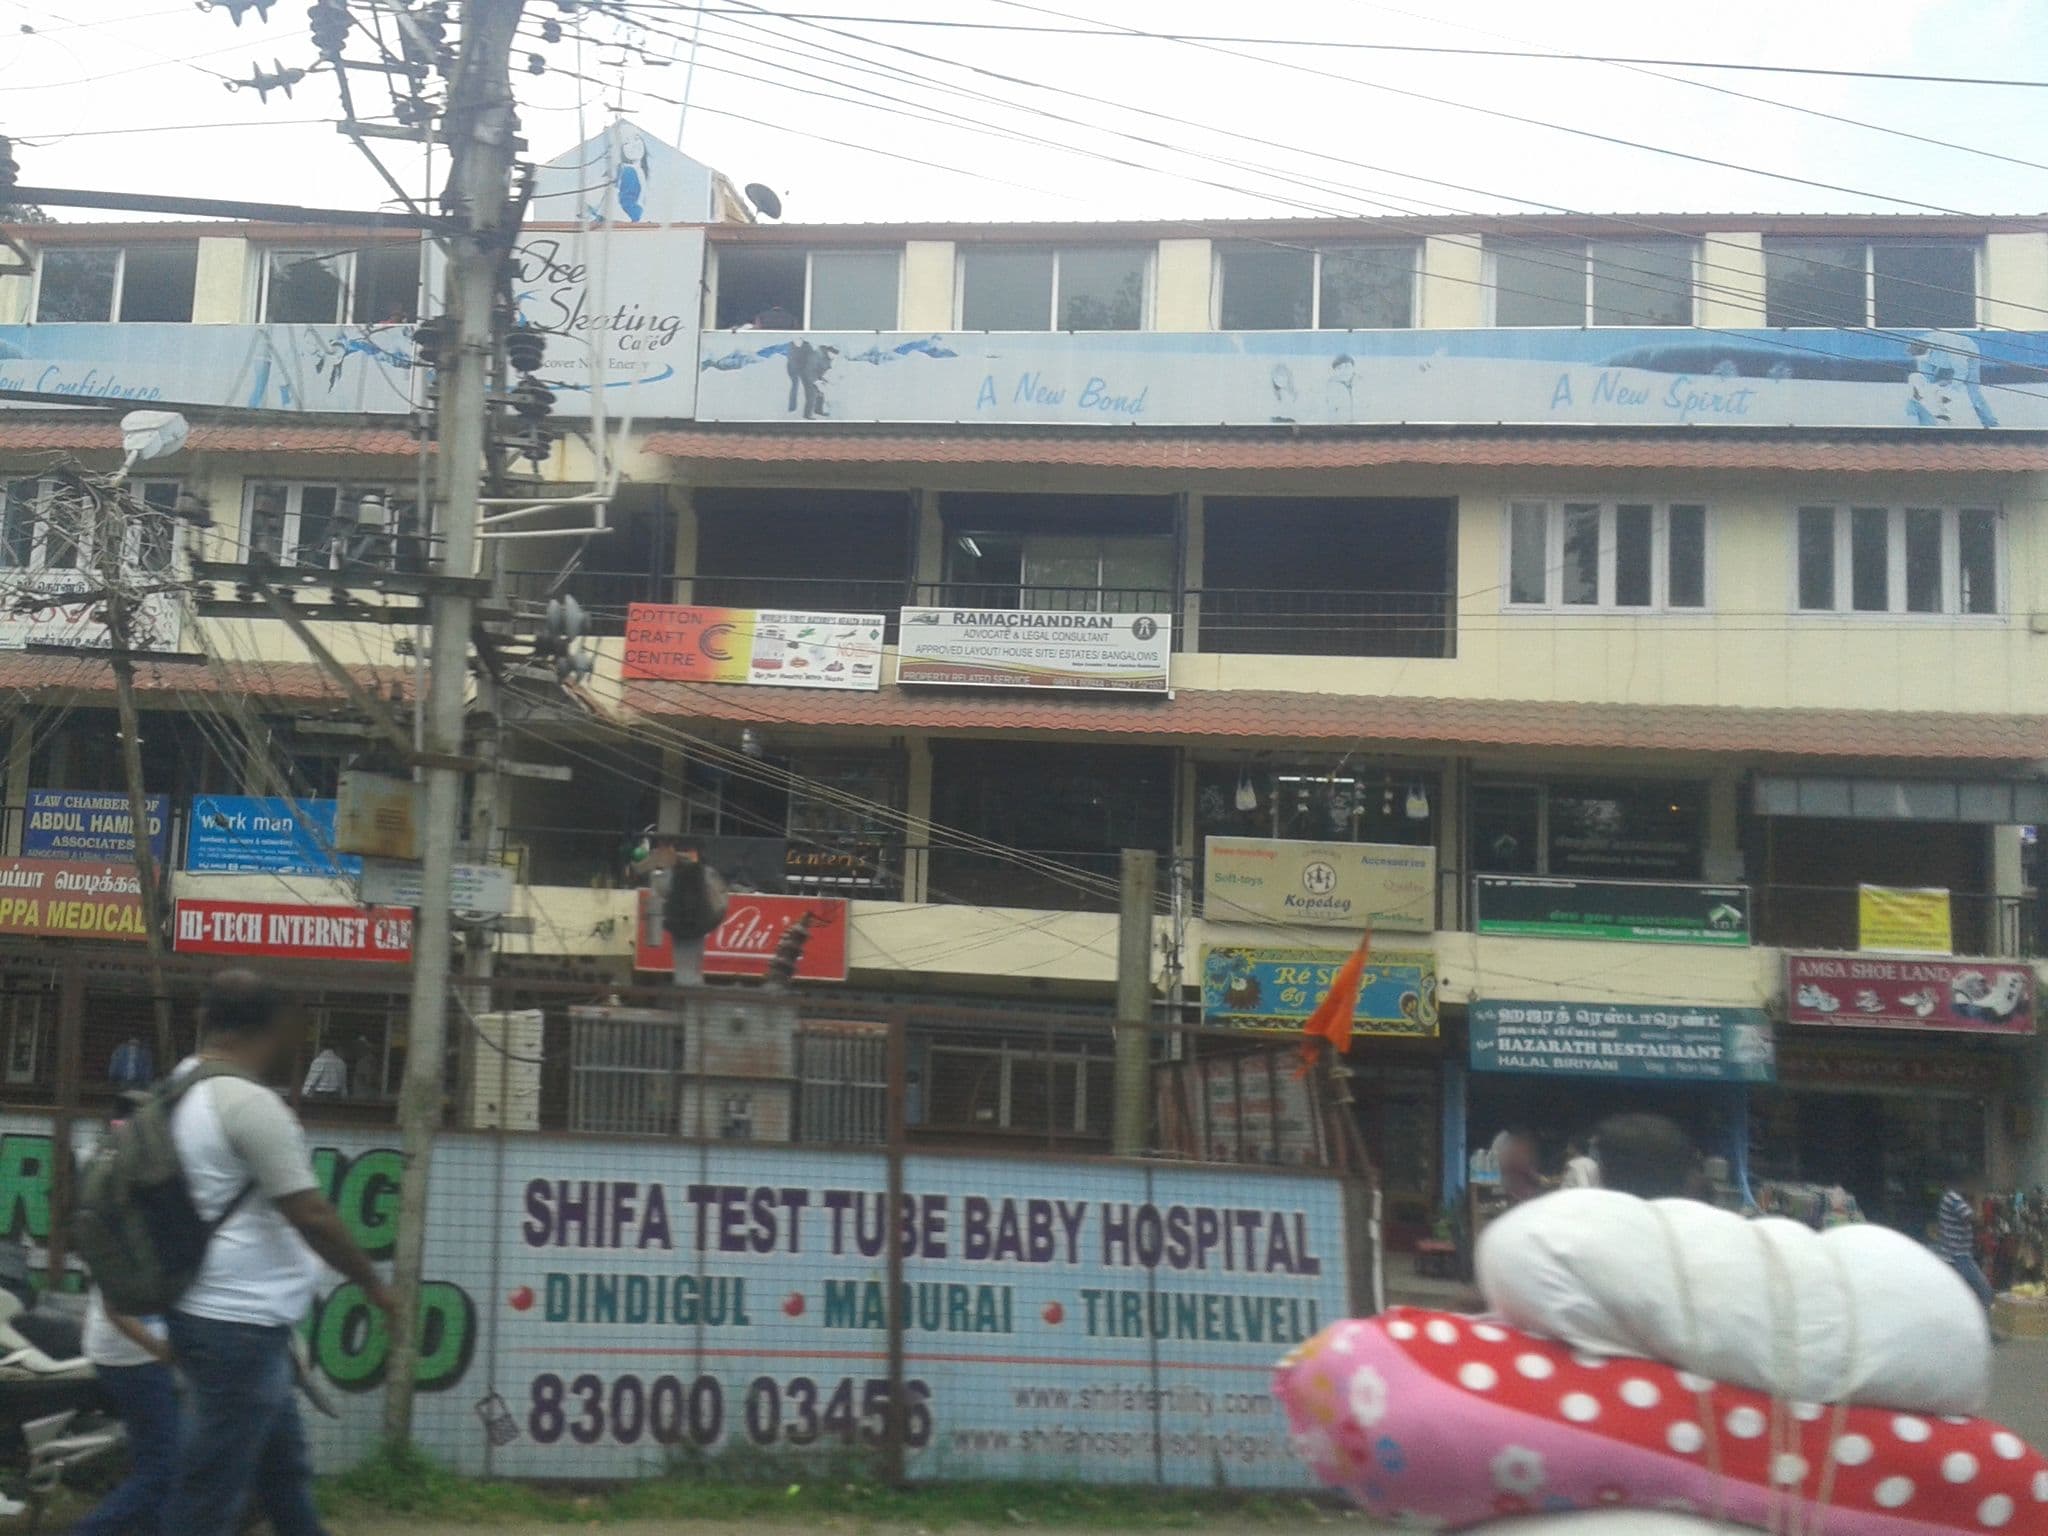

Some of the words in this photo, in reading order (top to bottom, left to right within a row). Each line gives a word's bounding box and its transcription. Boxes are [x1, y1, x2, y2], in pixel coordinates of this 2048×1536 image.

[512, 239, 588, 284] Ice
[533, 286, 685, 346] Skating
[619, 333, 659, 351] Caé
[0, 363, 25, 392] ew
[976, 375, 997, 411] A
[1014, 372, 1067, 405] New
[1078, 376, 1149, 415] Bond
[1550, 373, 1573, 410] A
[1592, 369, 1650, 406] New
[1664, 375, 1758, 421] Spirit
[630, 608, 703, 624] COTTON
[953, 611, 1113, 629] RAMACHANDRAN
[628, 629, 686, 644] CRAFT
[963, 629, 1011, 640] ADVOCATE
[1013, 631, 1020, 640] &
[1022, 630, 1049, 641] LEGAL
[1052, 632, 1110, 642] CONSULTANT
[625, 649, 696, 666] CENTRE
[915, 644, 964, 655] APPROVED
[1002, 647, 1033, 658] HOUSE
[1102, 650, 1158, 662] BANGALOWS
[903, 671, 948, 681] PROPERTY
[952, 673, 990, 683] RELATED
[993, 675, 1031, 685] SERVICE
[34, 795, 62, 808] LAW
[30, 811, 85, 832] ABDUL
[90, 815, 161, 836] HAMD
[202, 811, 247, 832] wrk
[253, 815, 293, 833] man
[52, 835, 136, 850] ASSOCIATES
[179, 910, 263, 944] HI-TECH
[267, 914, 369, 949] INTERNET
[1797, 961, 1846, 977] AMSA
[1851, 965, 1897, 980] SHOE
[1901, 967, 1950, 982] LAND
[1498, 1038, 1597, 1055] HAZARATH
[1601, 1041, 1723, 1060] RESTAURANT
[1498, 1055, 1549, 1069] HALAL
[1553, 1057, 1619, 1072] BIRIYANI
[522, 1178, 673, 1250] SHIFA
[687, 1184, 809, 1254] TEST
[824, 1189, 949, 1259] TUBE
[963, 1195, 1088, 1264] BABY
[1102, 1202, 1320, 1275] HOSPITAL
[545, 1272, 750, 1327] DINDIGUL
[823, 1278, 1013, 1335] MADURAI
[1080, 1288, 1318, 1344] TIRUNELVELI
[528, 1372, 725, 1445] 83000
[745, 1375, 932, 1448] 03456
